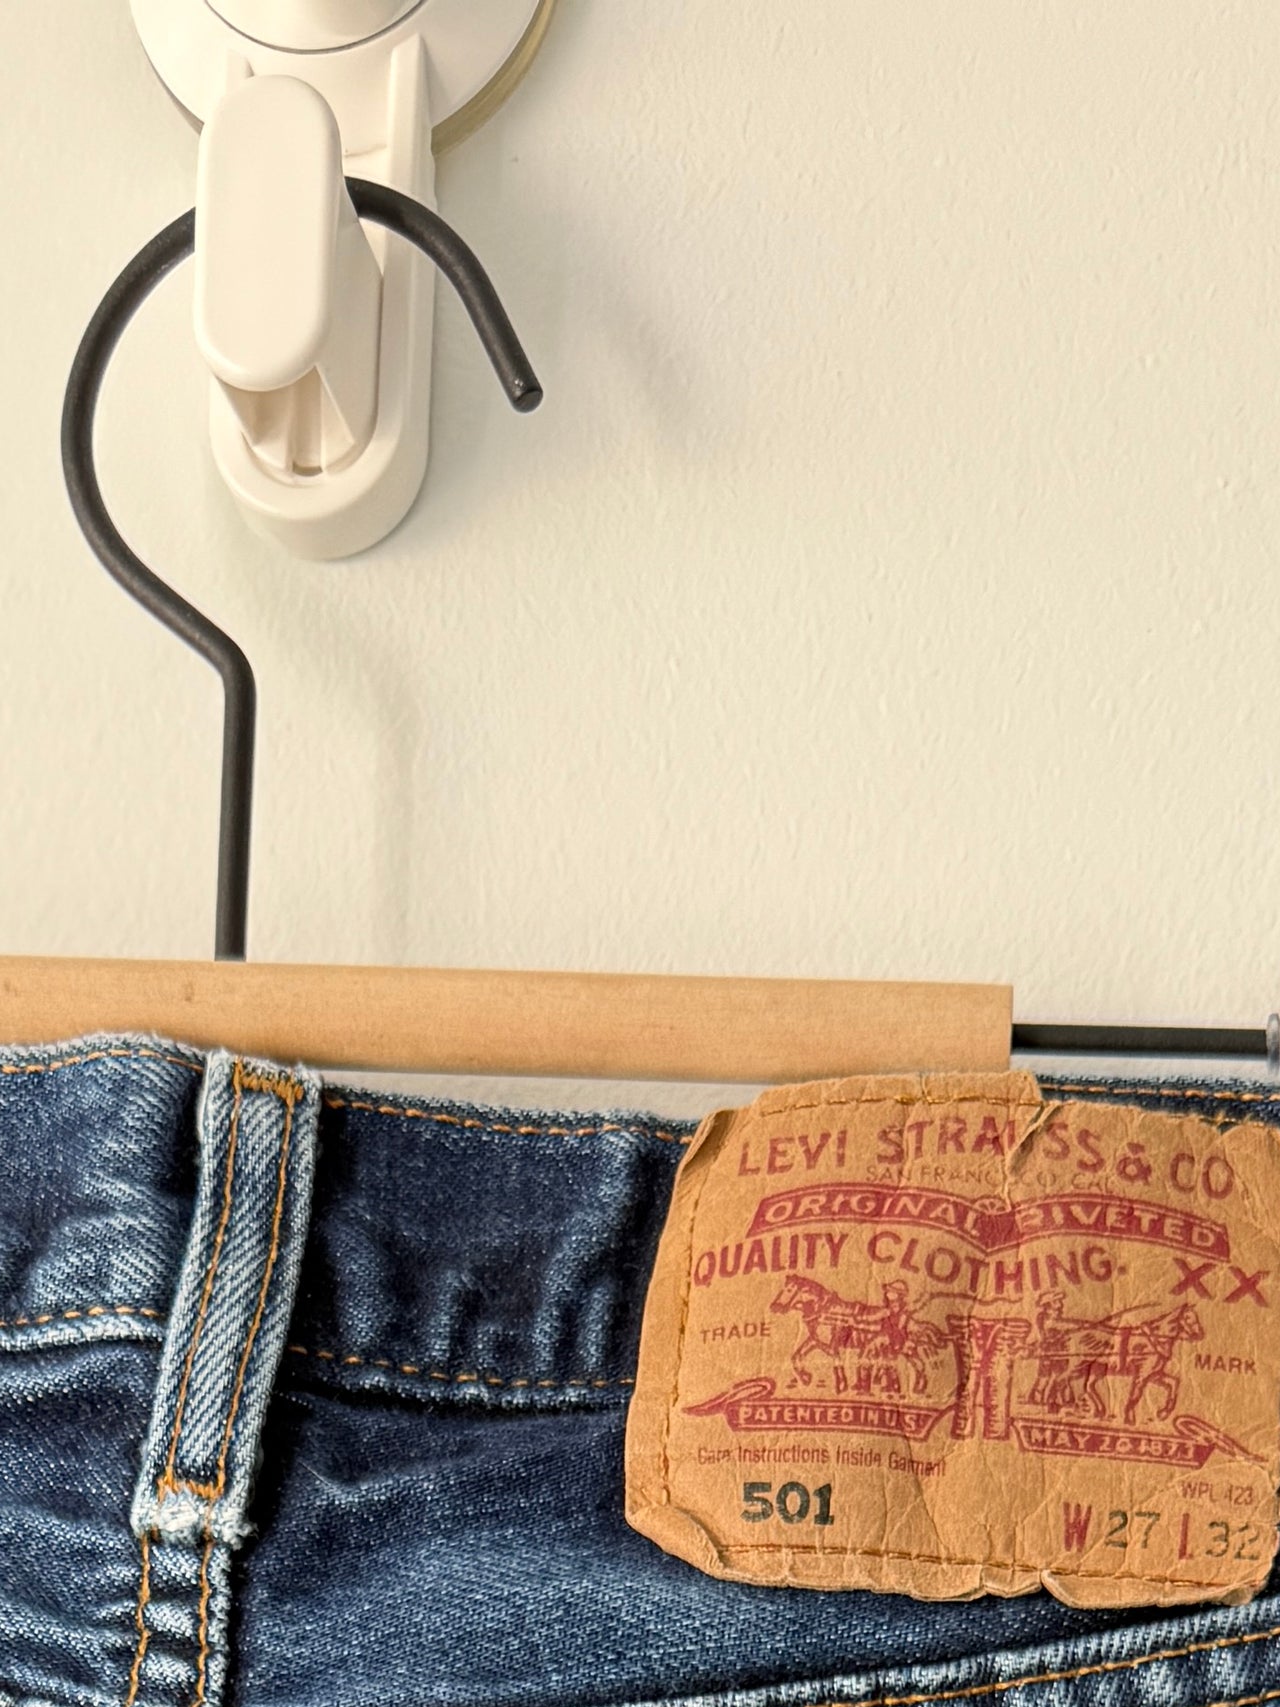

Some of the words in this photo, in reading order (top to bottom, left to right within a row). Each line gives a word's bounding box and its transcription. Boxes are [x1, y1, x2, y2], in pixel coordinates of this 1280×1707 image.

[738, 1129, 848, 1177] LEVI
[1116, 1142, 1152, 1186] &
[866, 1165, 914, 1184] SAN
[921, 1164, 1057, 1189] FRANCCO
[764, 1193, 981, 1238] ORIGINAL
[1014, 1203, 1215, 1248] RIVETED
[693, 1232, 849, 1288] QUALITY
[700, 1322, 772, 1343] TRADE
[1193, 1353, 1257, 1375] MARK
[739, 1406, 854, 1424] PATENTED
[860, 1407, 879, 1425] IN
[1030, 1428, 1091, 1450] MAY
[738, 1444, 829, 1464] Instructions
[836, 1445, 881, 1468] Inside
[740, 1481, 835, 1526] 501
[1063, 1501, 1092, 1551] W
[1105, 1509, 1160, 1549] 27
[1205, 1521, 1259, 1560] 32
